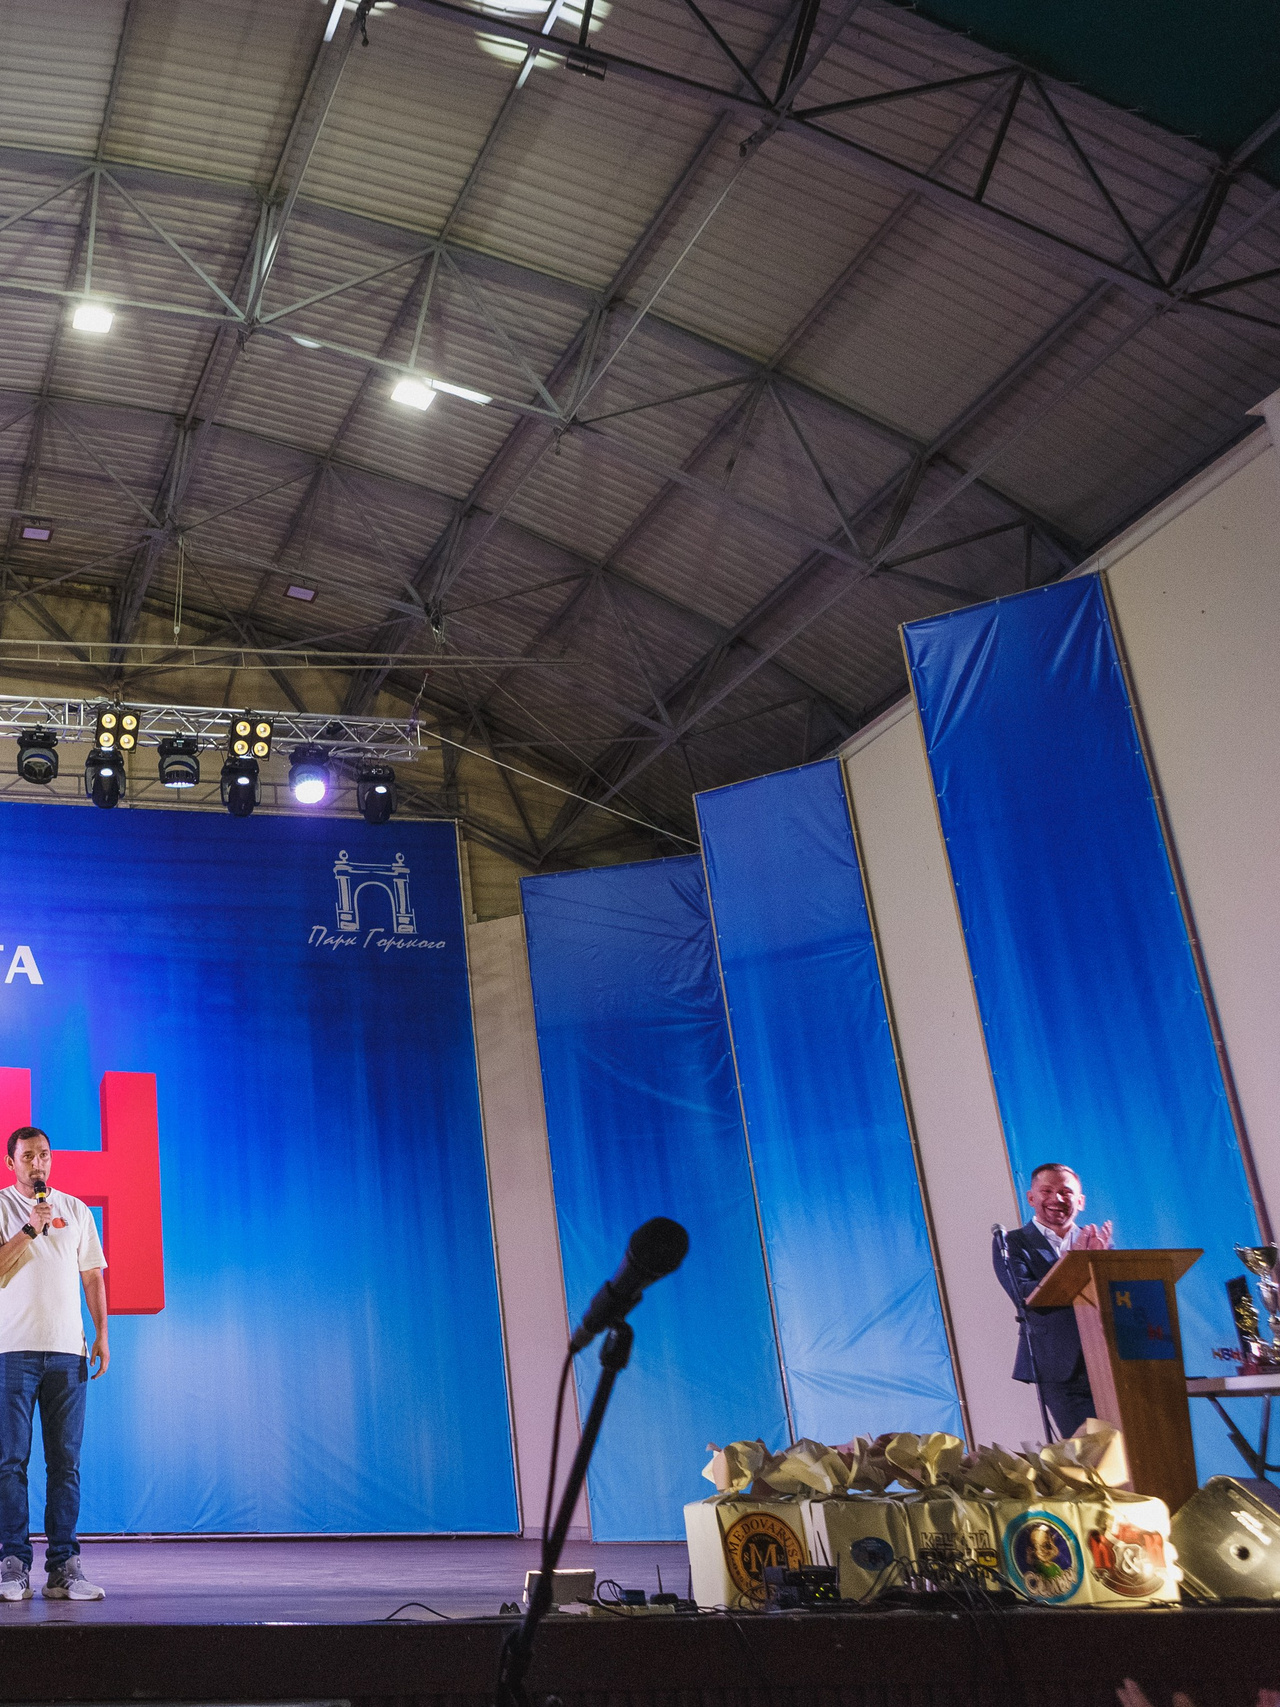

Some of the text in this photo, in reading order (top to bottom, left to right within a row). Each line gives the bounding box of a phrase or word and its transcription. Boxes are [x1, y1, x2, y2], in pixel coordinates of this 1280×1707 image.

[308, 925, 446, 952] Парк Горького
[728, 1518, 799, 1557] MEDOVARUS
[749, 1543, 777, 1572] M
